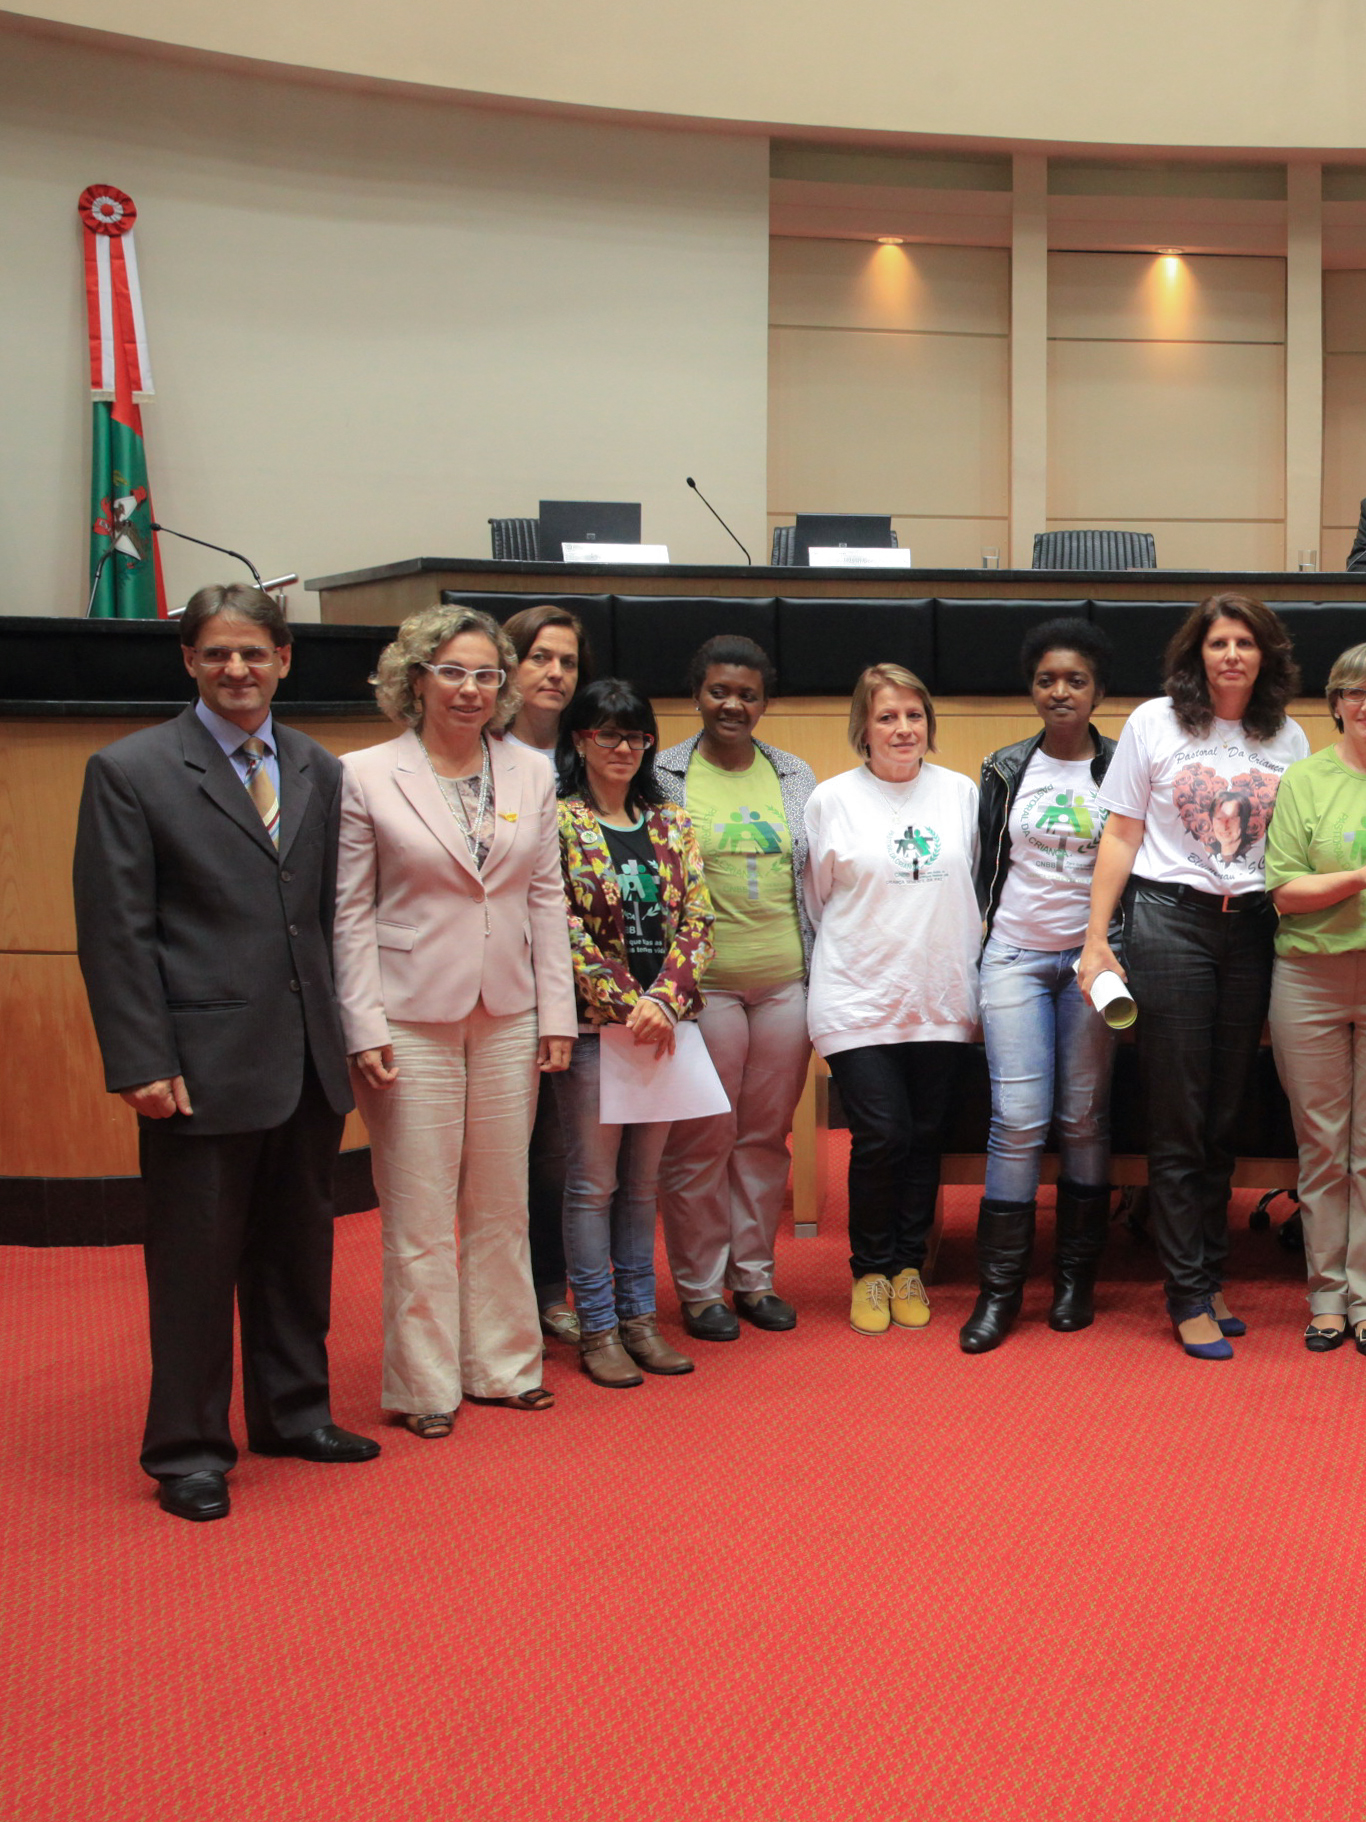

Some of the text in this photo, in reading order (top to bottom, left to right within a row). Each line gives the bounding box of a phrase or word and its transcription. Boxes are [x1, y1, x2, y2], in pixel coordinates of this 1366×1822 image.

[1175, 746, 1285, 773] Pastoral Da Criança
[1021, 784, 1054, 822] PASTORAL
[1021, 823, 1030, 838] DA
[1035, 860, 1056, 869] CNBB
